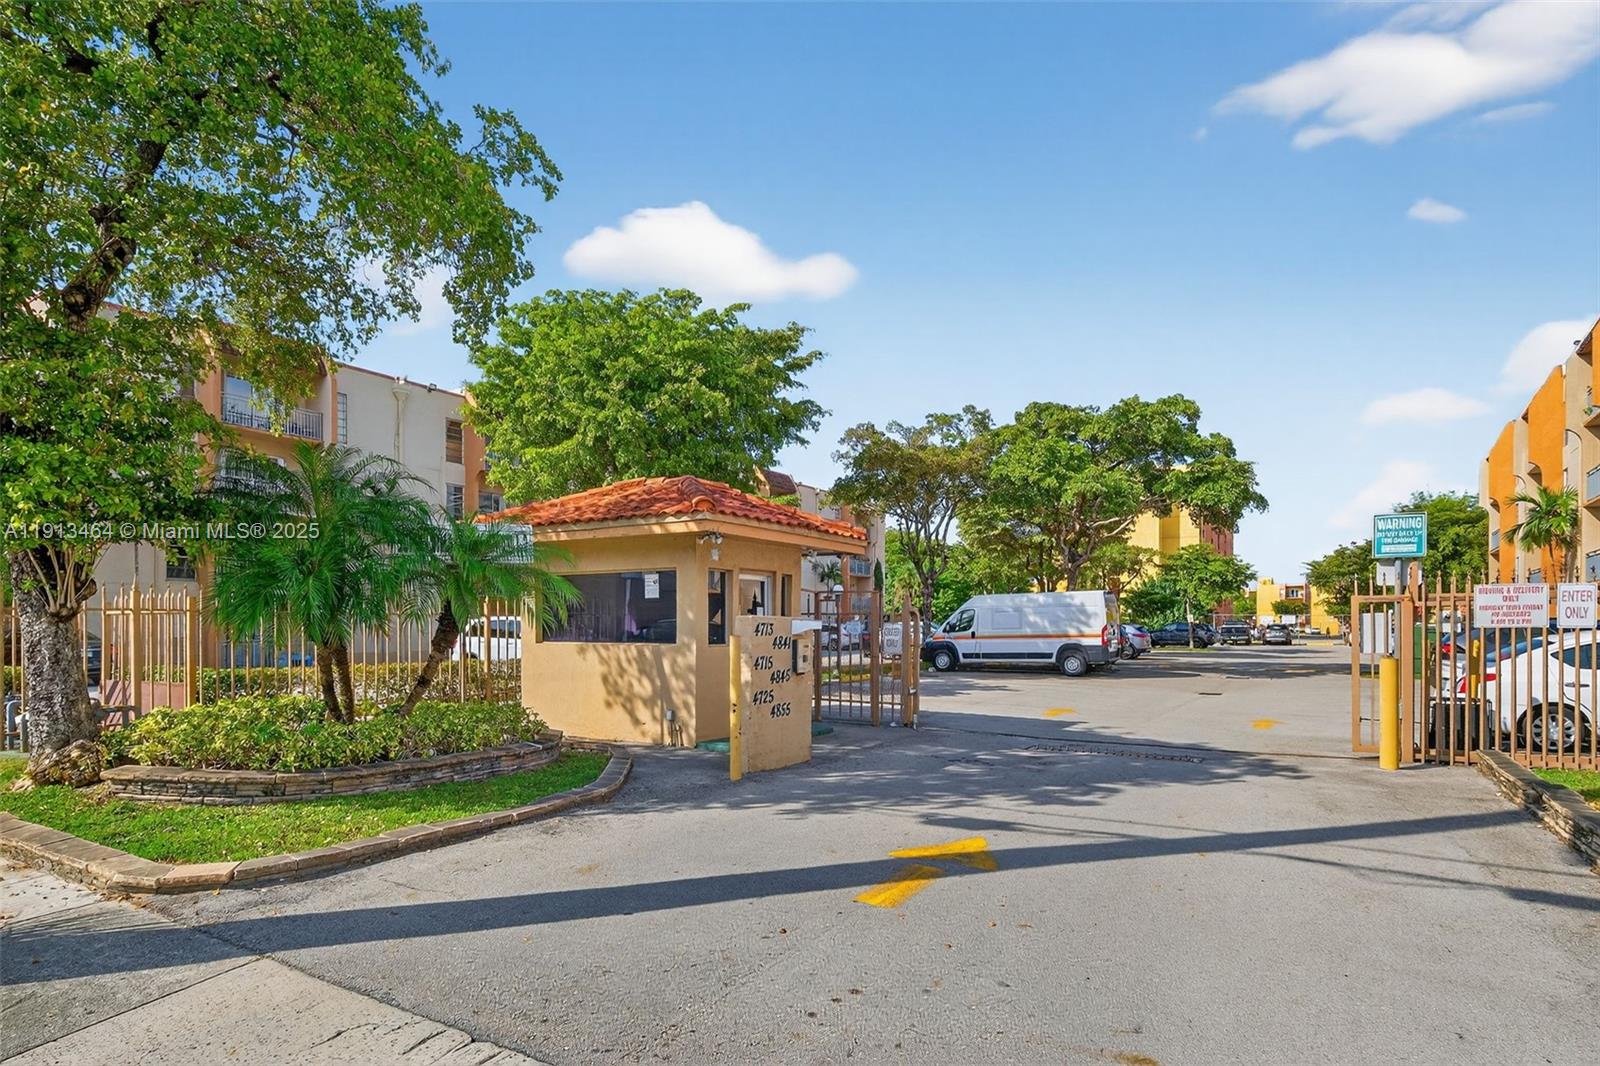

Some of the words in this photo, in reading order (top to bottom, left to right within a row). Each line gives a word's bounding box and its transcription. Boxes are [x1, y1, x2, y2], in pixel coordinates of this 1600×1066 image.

[1377, 517, 1422, 530] WARNING
[1561, 590, 1593, 602] ENTER
[1565, 606, 1589, 619] ONLY
[754, 622, 774, 636] 4713
[772, 635, 792, 650] 4841
[753, 656, 773, 670] 4715
[770, 669, 791, 684] 4845
[753, 689, 774, 705] 4725
[770, 702, 791, 718] 4855
